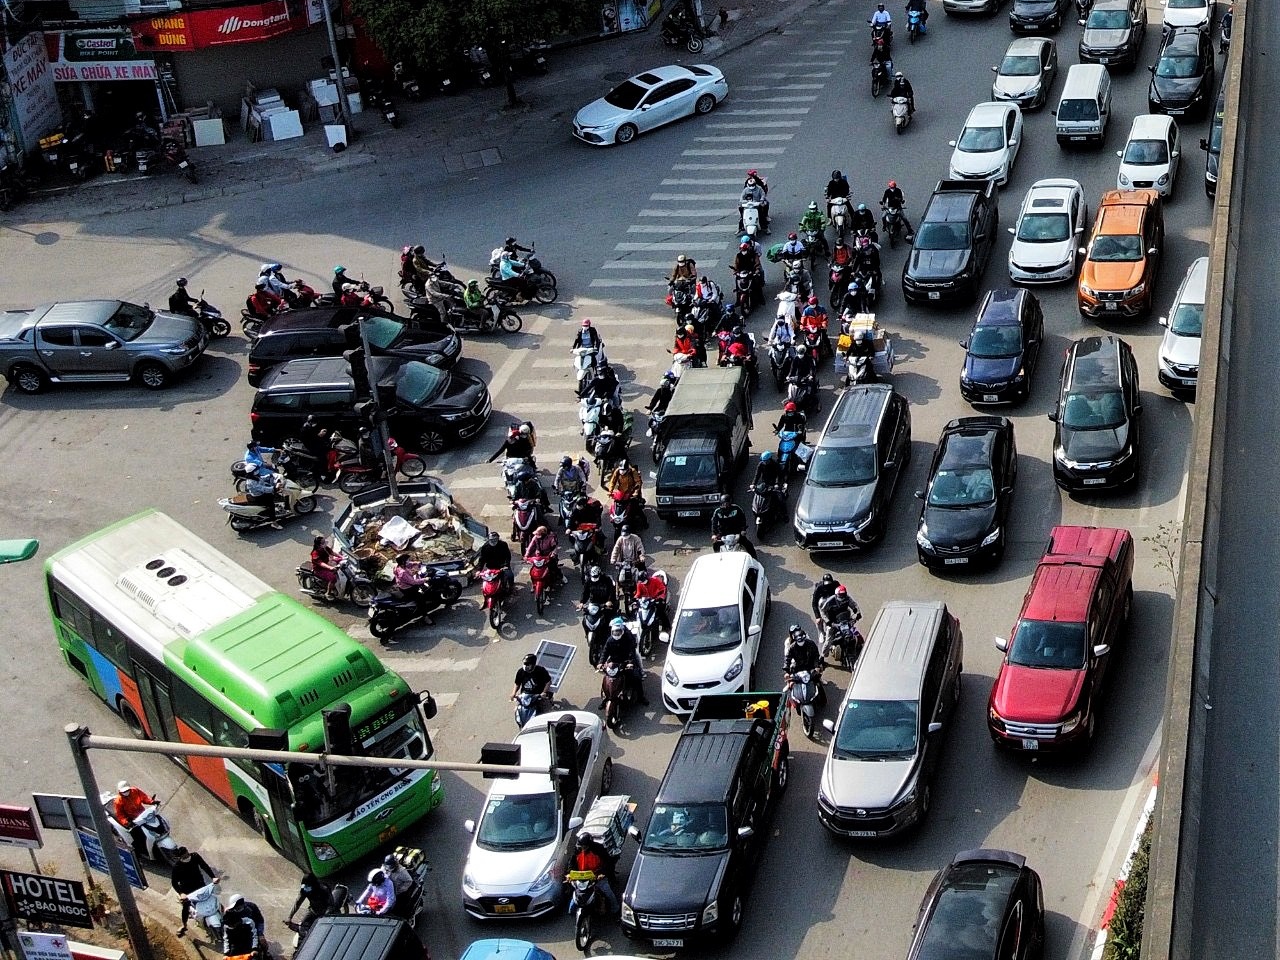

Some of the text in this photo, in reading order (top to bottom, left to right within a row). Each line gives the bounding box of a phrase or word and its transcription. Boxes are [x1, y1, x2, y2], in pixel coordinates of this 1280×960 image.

[242, 13, 289, 28] Dongtam
[86, 40, 115, 48] Castrol
[159, 31, 187, 45] DŨNG
[54, 63, 79, 80] SỬA
[81, 63, 113, 80] CHỮA
[115, 65, 129, 78] XE
[13, 76, 28, 96] XE
[10, 873, 85, 905] HOTEL
[35, 900, 88, 917] BAO NGOC
